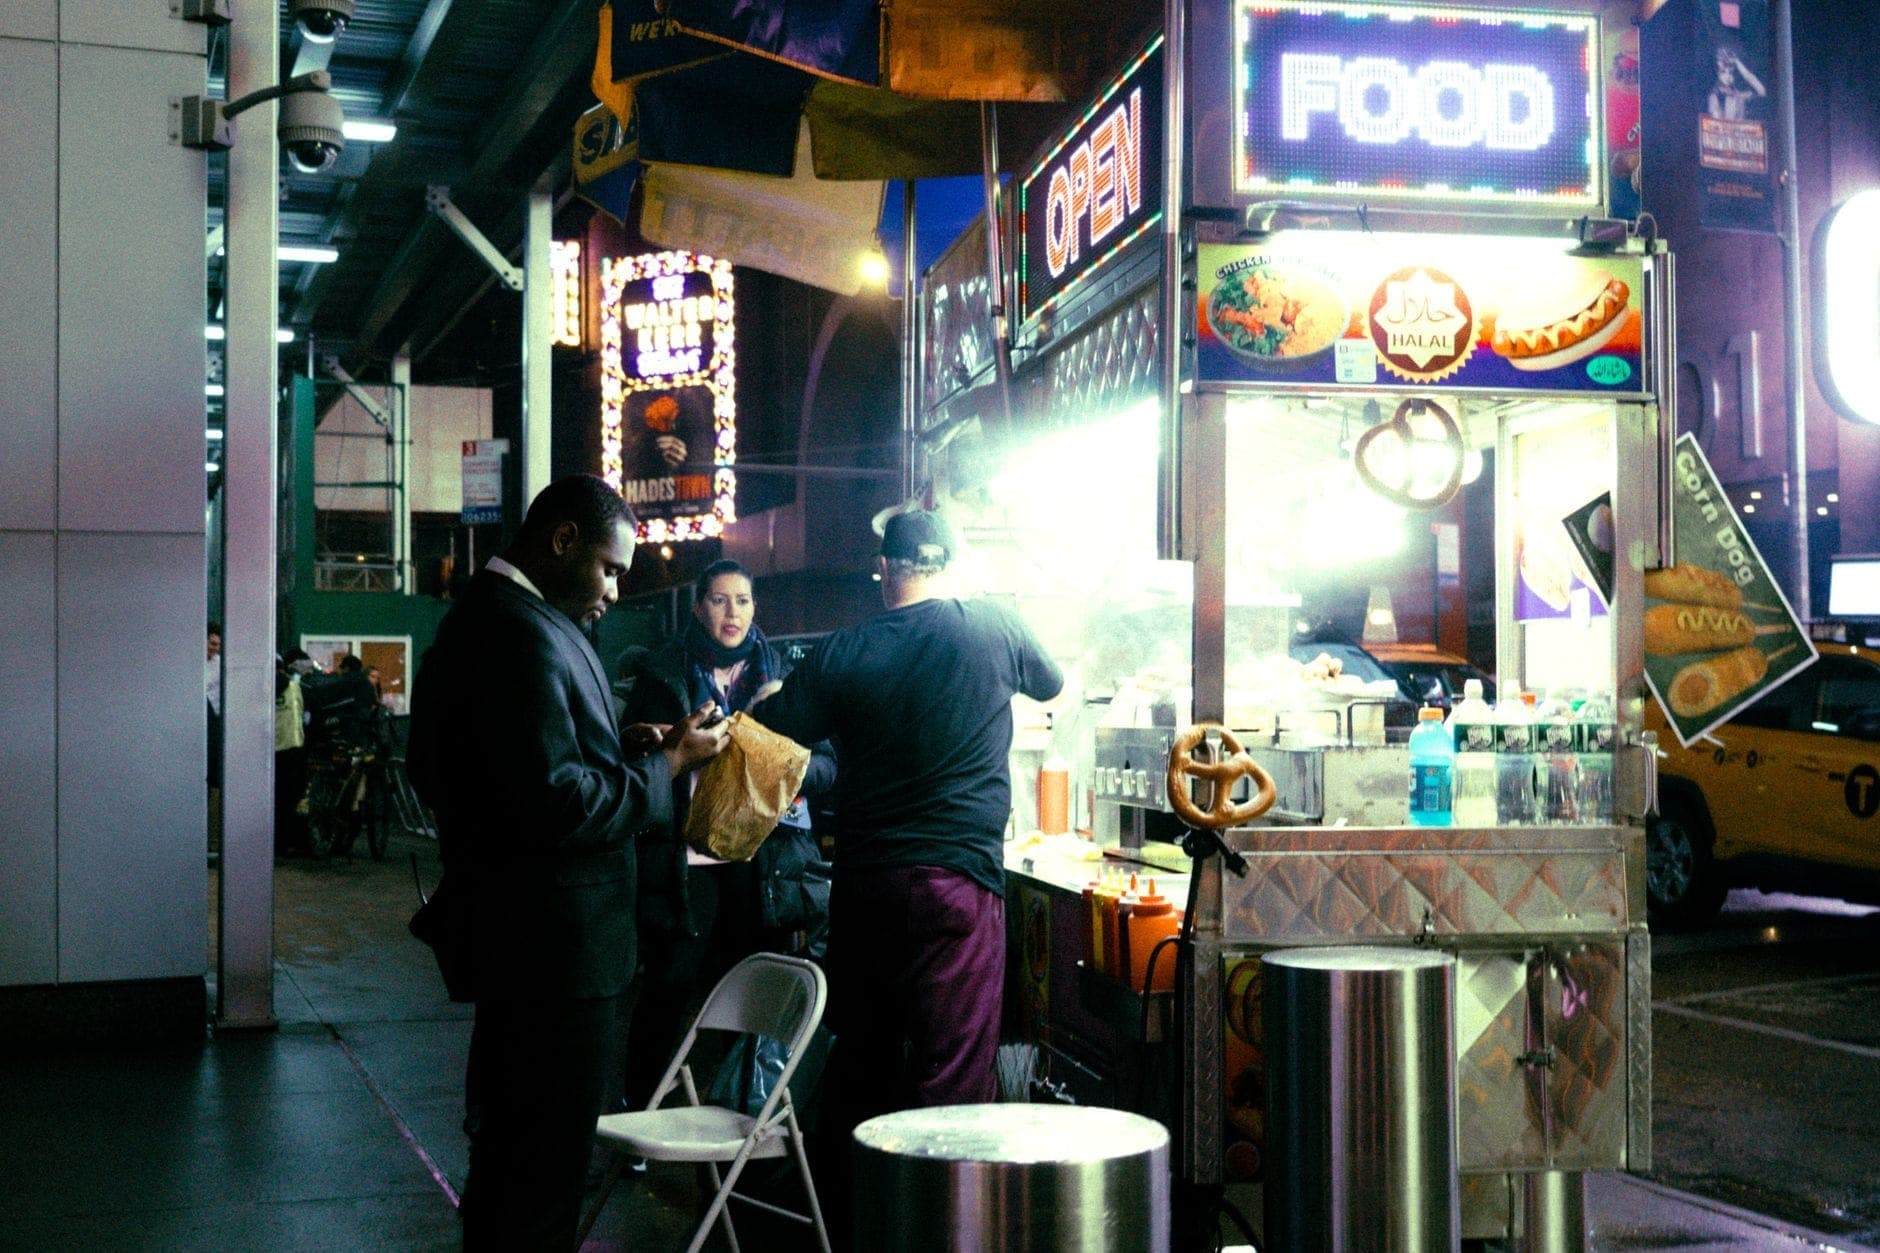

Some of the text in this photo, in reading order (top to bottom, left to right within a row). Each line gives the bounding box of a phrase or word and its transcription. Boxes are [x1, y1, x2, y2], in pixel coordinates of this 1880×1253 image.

[1281, 52, 1555, 151] FOOD
[1046, 86, 1141, 279] OPEN
[1392, 333, 1452, 349] HALAL
[1677, 451, 1755, 587] Corn Dog
